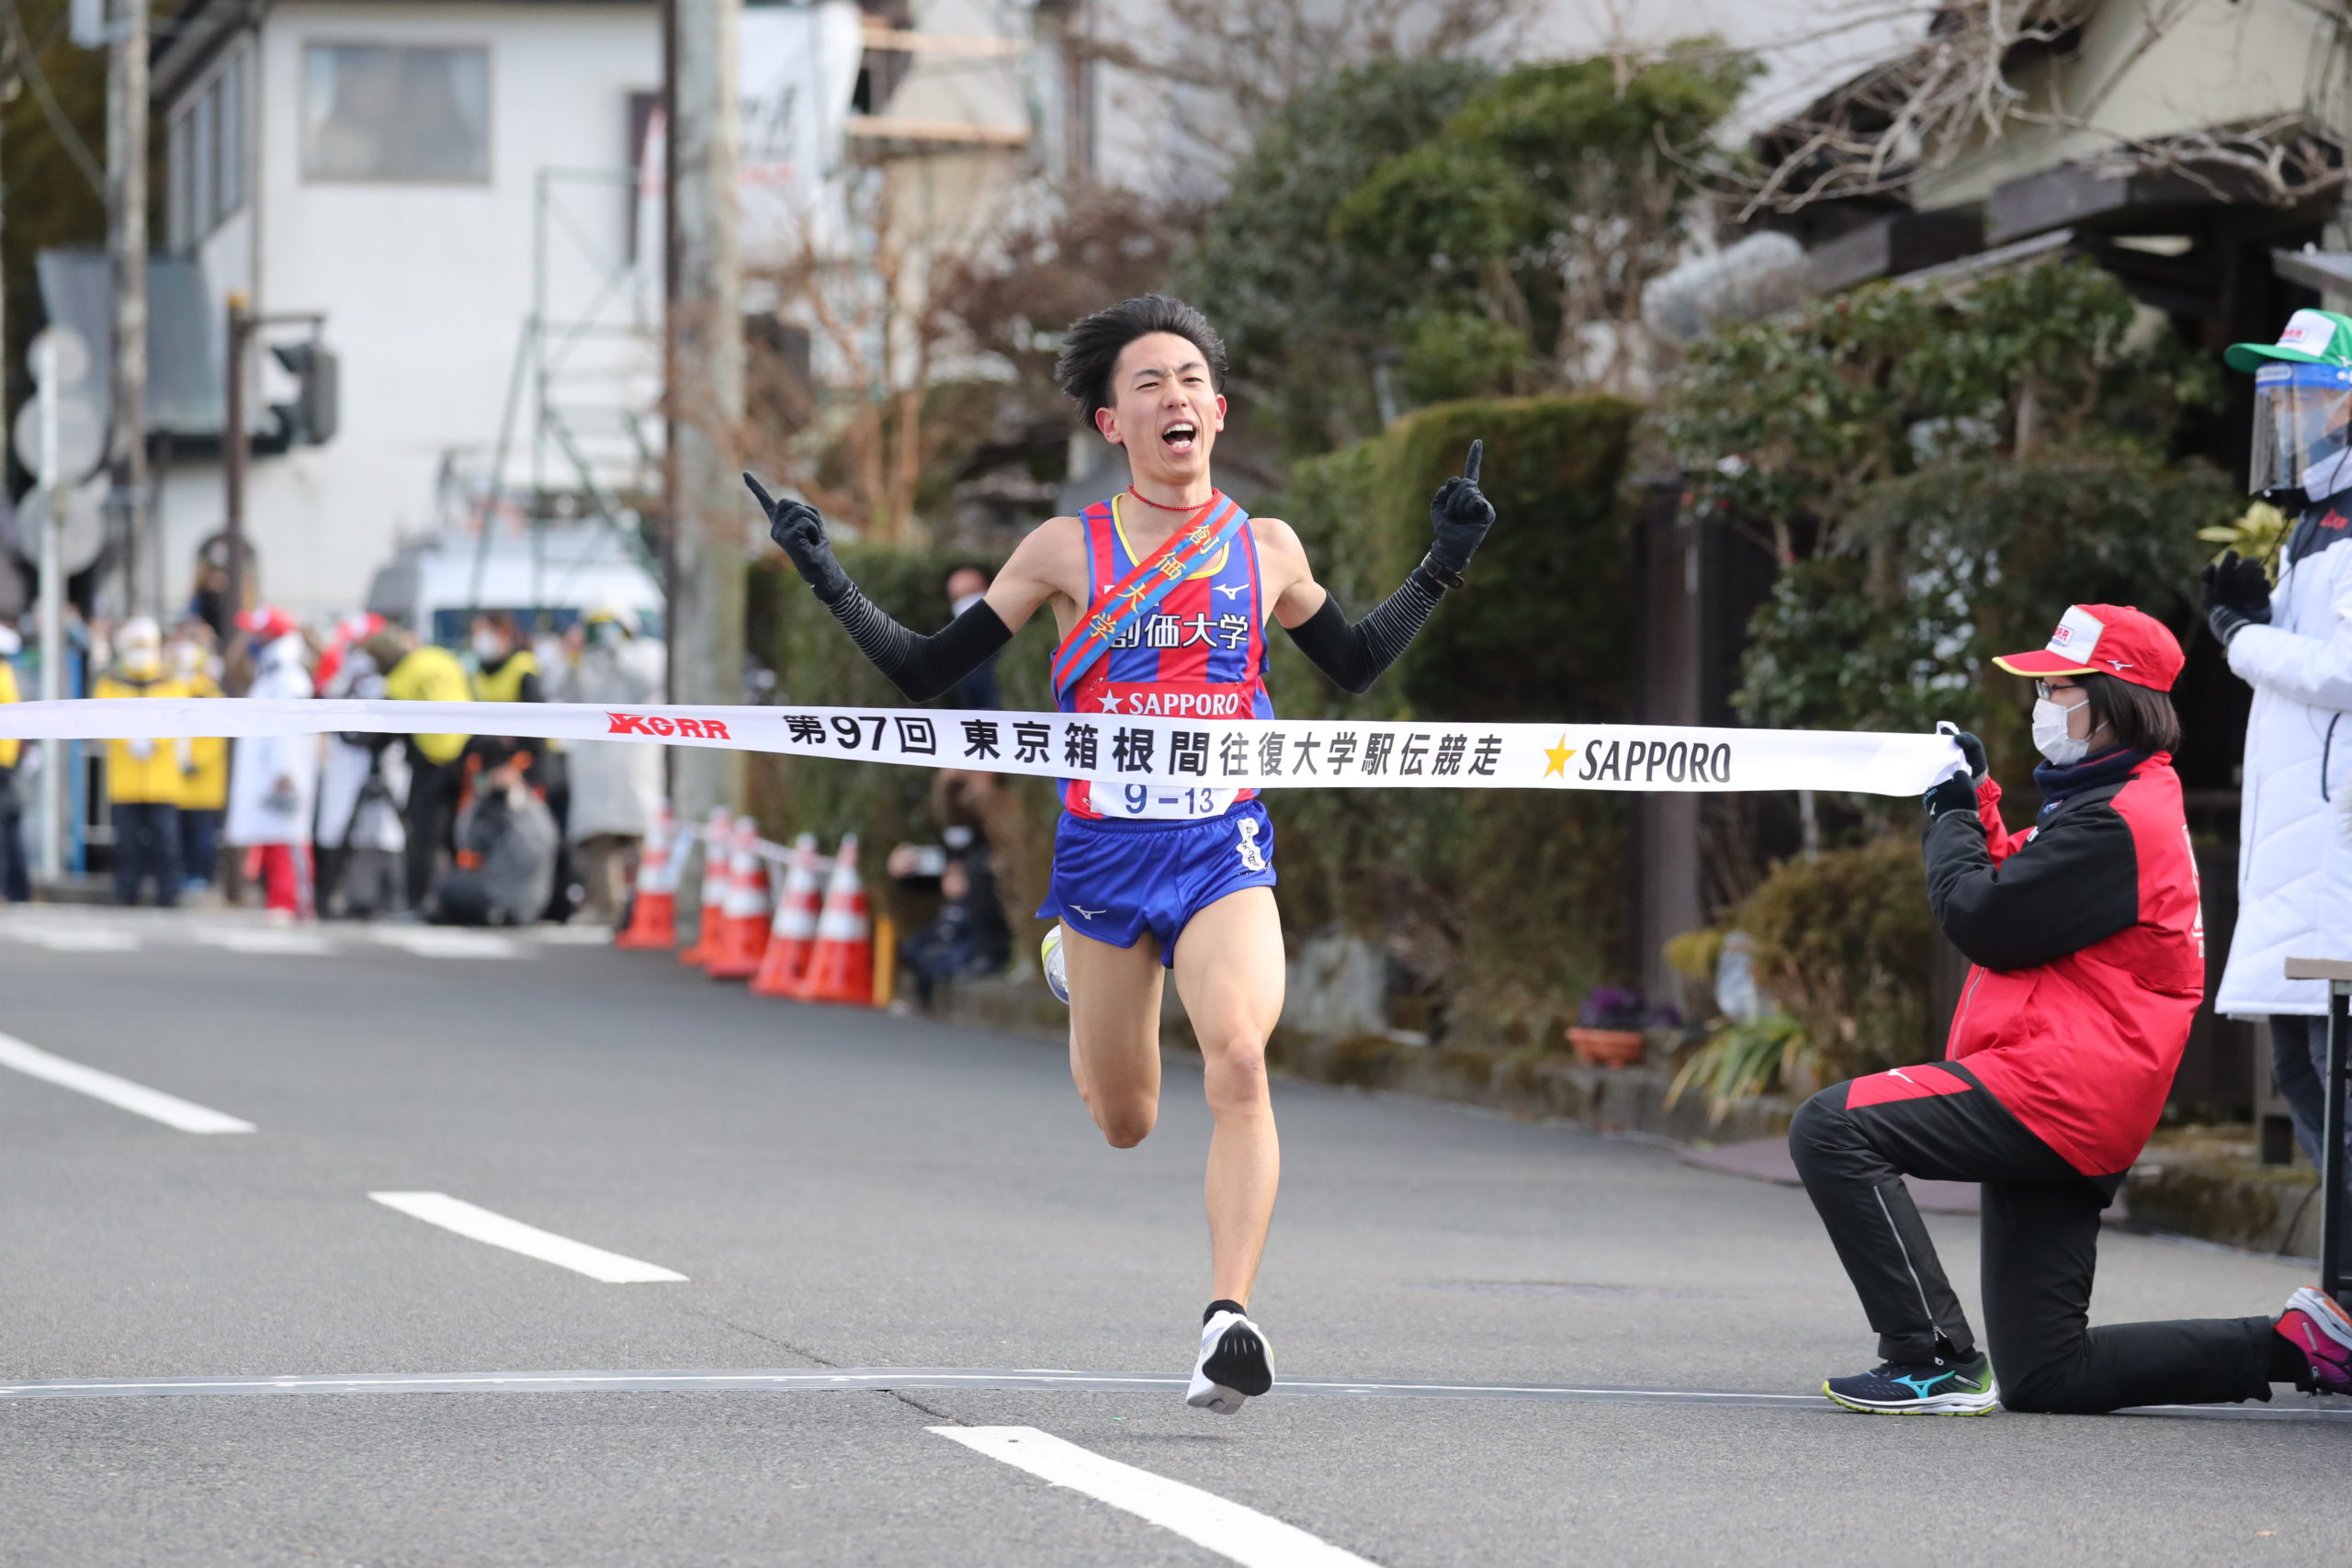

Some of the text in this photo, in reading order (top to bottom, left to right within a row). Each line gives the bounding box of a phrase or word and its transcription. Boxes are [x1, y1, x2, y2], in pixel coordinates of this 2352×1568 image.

[1090, 525, 1220, 640] 創価大学
[605, 711, 731, 740] KGRR
[1128, 692, 1239, 716] SAPPORO
[783, 714, 1502, 777] 第97回 東京箱根間往復大学駅伝競走
[1579, 739, 1732, 784] SAPPORO
